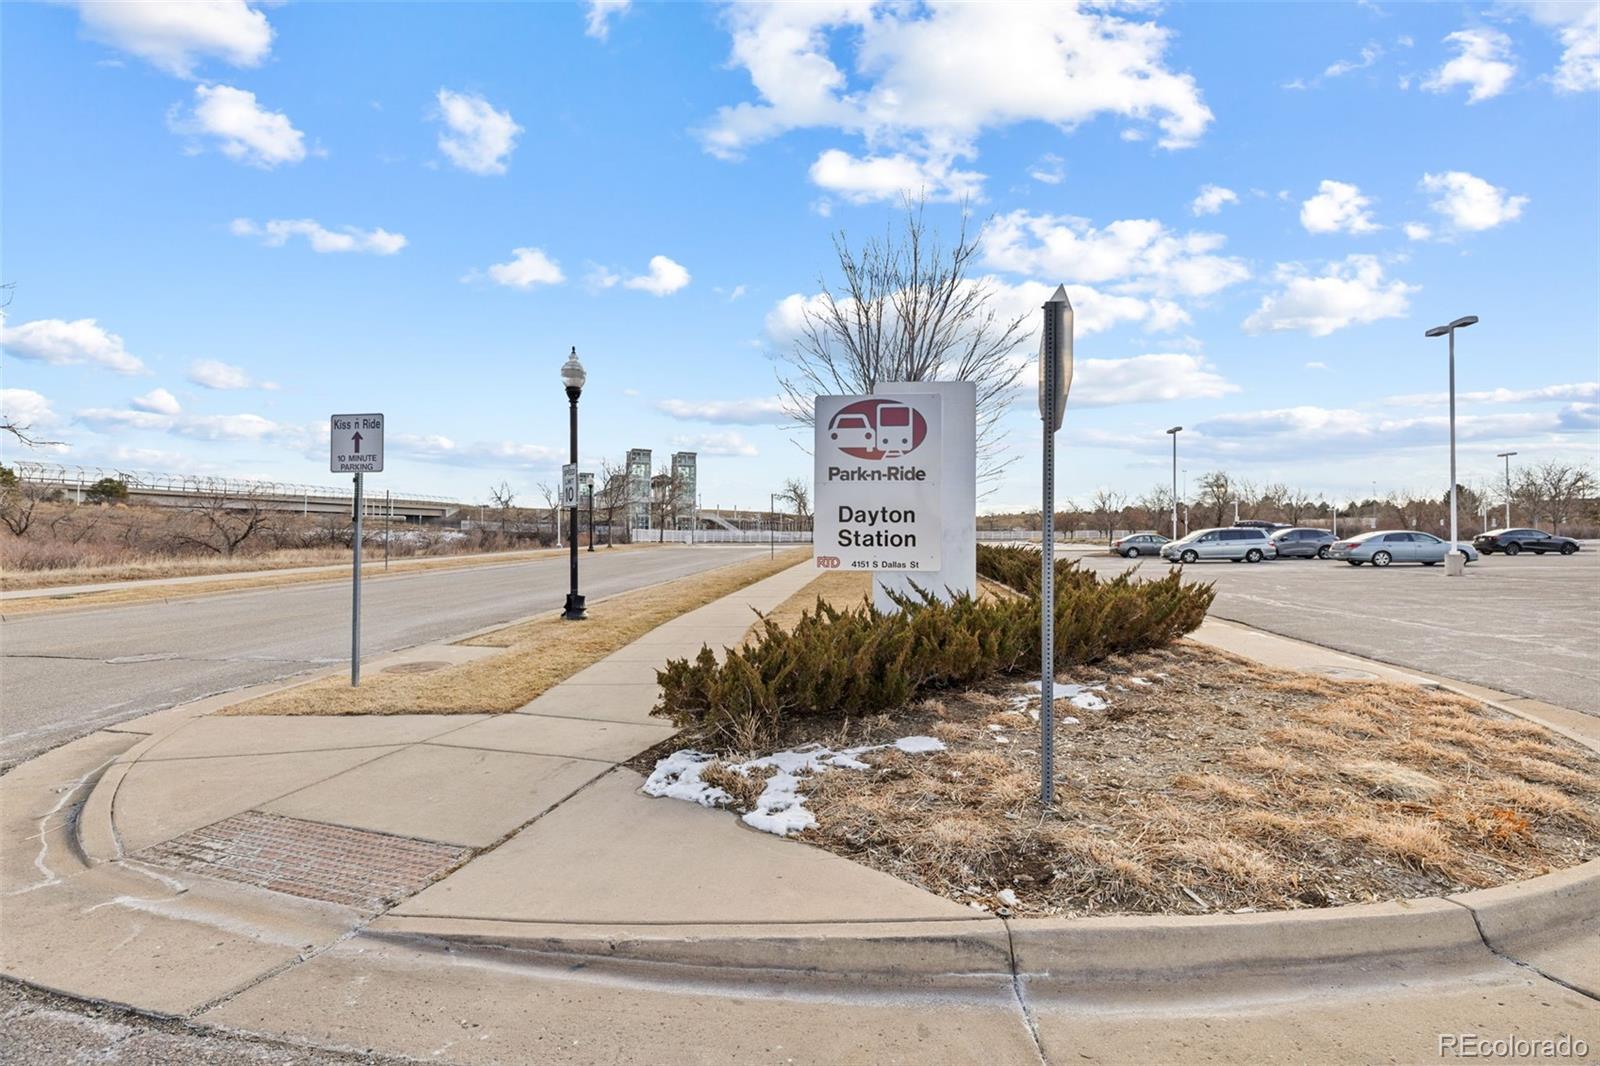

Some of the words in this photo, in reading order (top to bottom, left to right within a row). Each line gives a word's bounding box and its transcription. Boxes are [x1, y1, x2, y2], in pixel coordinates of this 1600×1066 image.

[334, 419, 351, 430] Kiss
[362, 418, 381, 429] Ride
[340, 463, 374, 471] PARKING
[828, 466, 926, 481] Park-n-Ride
[838, 506, 916, 526] Dayton
[837, 529, 917, 548] Station
[816, 556, 841, 569] RTD
[851, 560, 870, 569] 4151
[872, 560, 879, 569] S
[881, 560, 907, 569] Dallas
[909, 560, 920, 569] St
